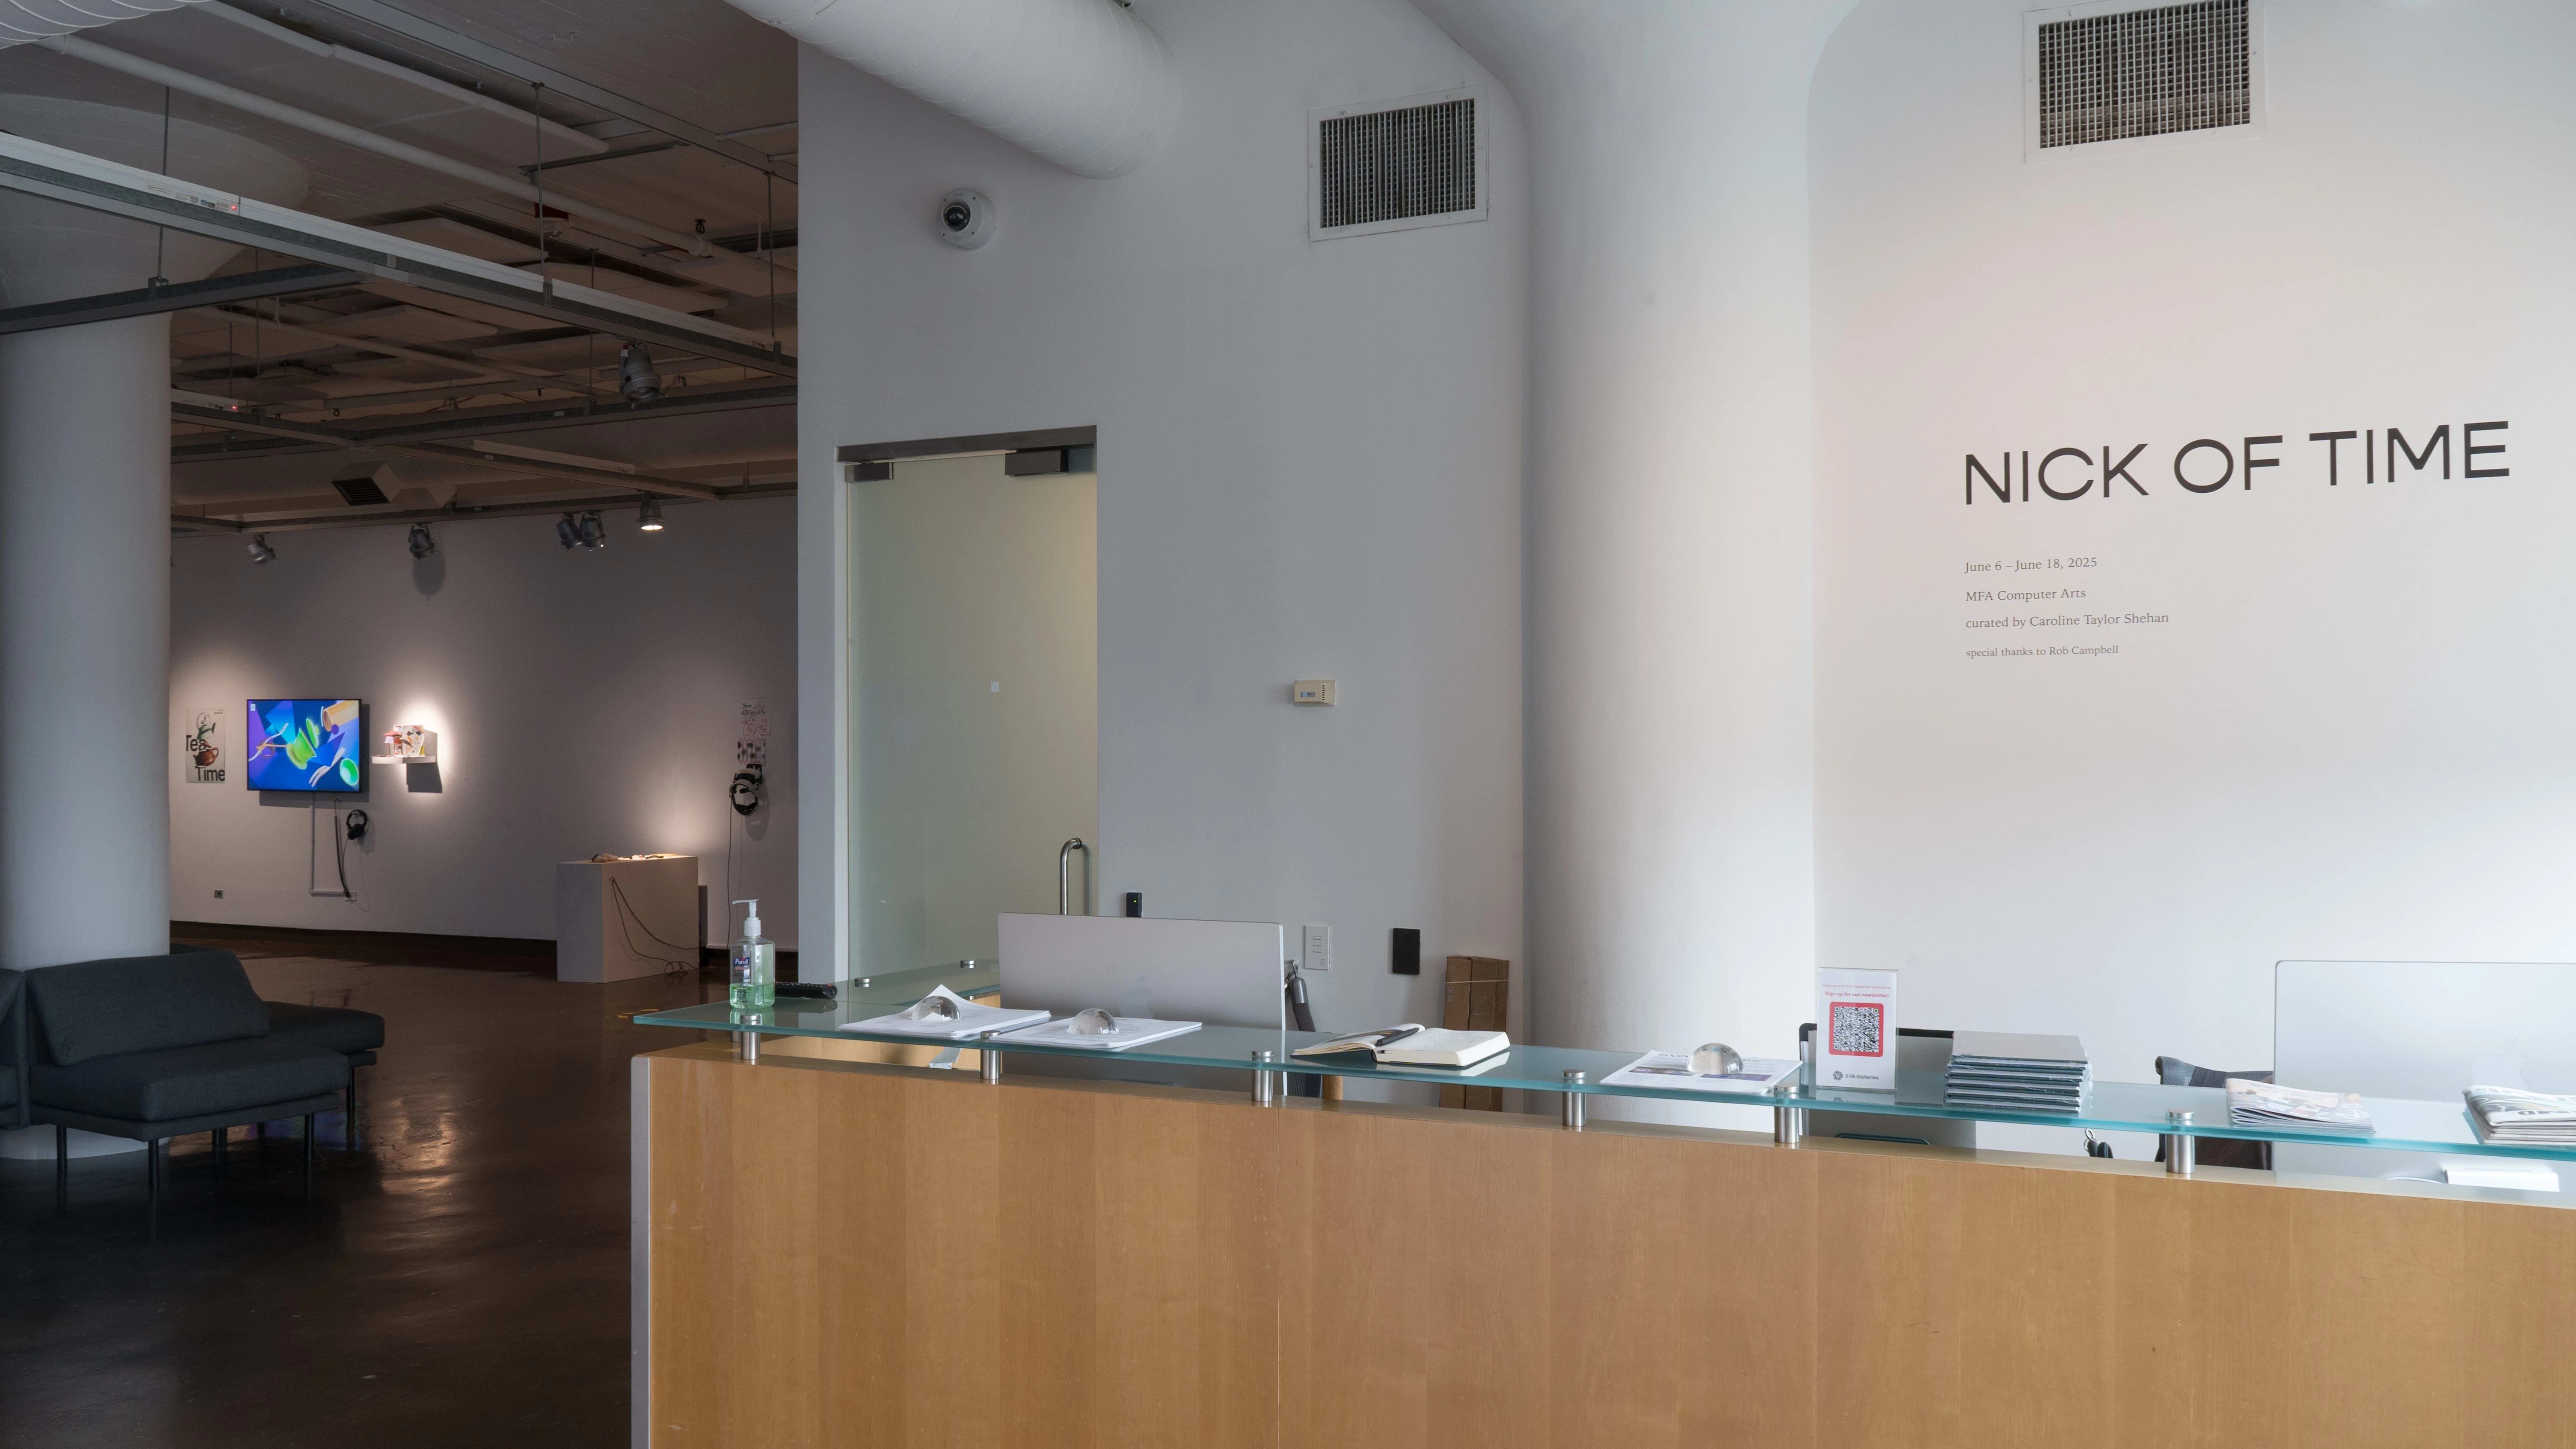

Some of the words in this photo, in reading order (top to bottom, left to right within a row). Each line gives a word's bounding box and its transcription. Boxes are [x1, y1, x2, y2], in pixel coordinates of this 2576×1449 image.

[1965, 443, 2150, 505] NICK
[2173, 434, 2283, 494] OF
[2309, 420, 2510, 486] TIME
[1964, 562, 1991, 574] June
[1995, 561, 2002, 571] 6
[2014, 560, 2042, 572] June
[2047, 558, 2063, 570] 18,
[2068, 557, 2097, 568] 2025
[1965, 591, 1993, 601] MFA
[1997, 590, 2057, 603] Computer
[2060, 588, 2086, 598] Arts
[1965, 616, 2008, 628] curated
[2012, 616, 2026, 630] by
[2030, 615, 2080, 626] Caroline
[2083, 614, 2121, 627] Taylor
[2124, 612, 2169, 624] Shehan
[1966, 648, 1998, 659] special
[2001, 647, 2033, 656] thanks
[2049, 646, 2069, 655] Rob
[2071, 645, 2119, 657] Campbell
[186, 734, 206, 752] Tea
[195, 766, 225, 781] Time
